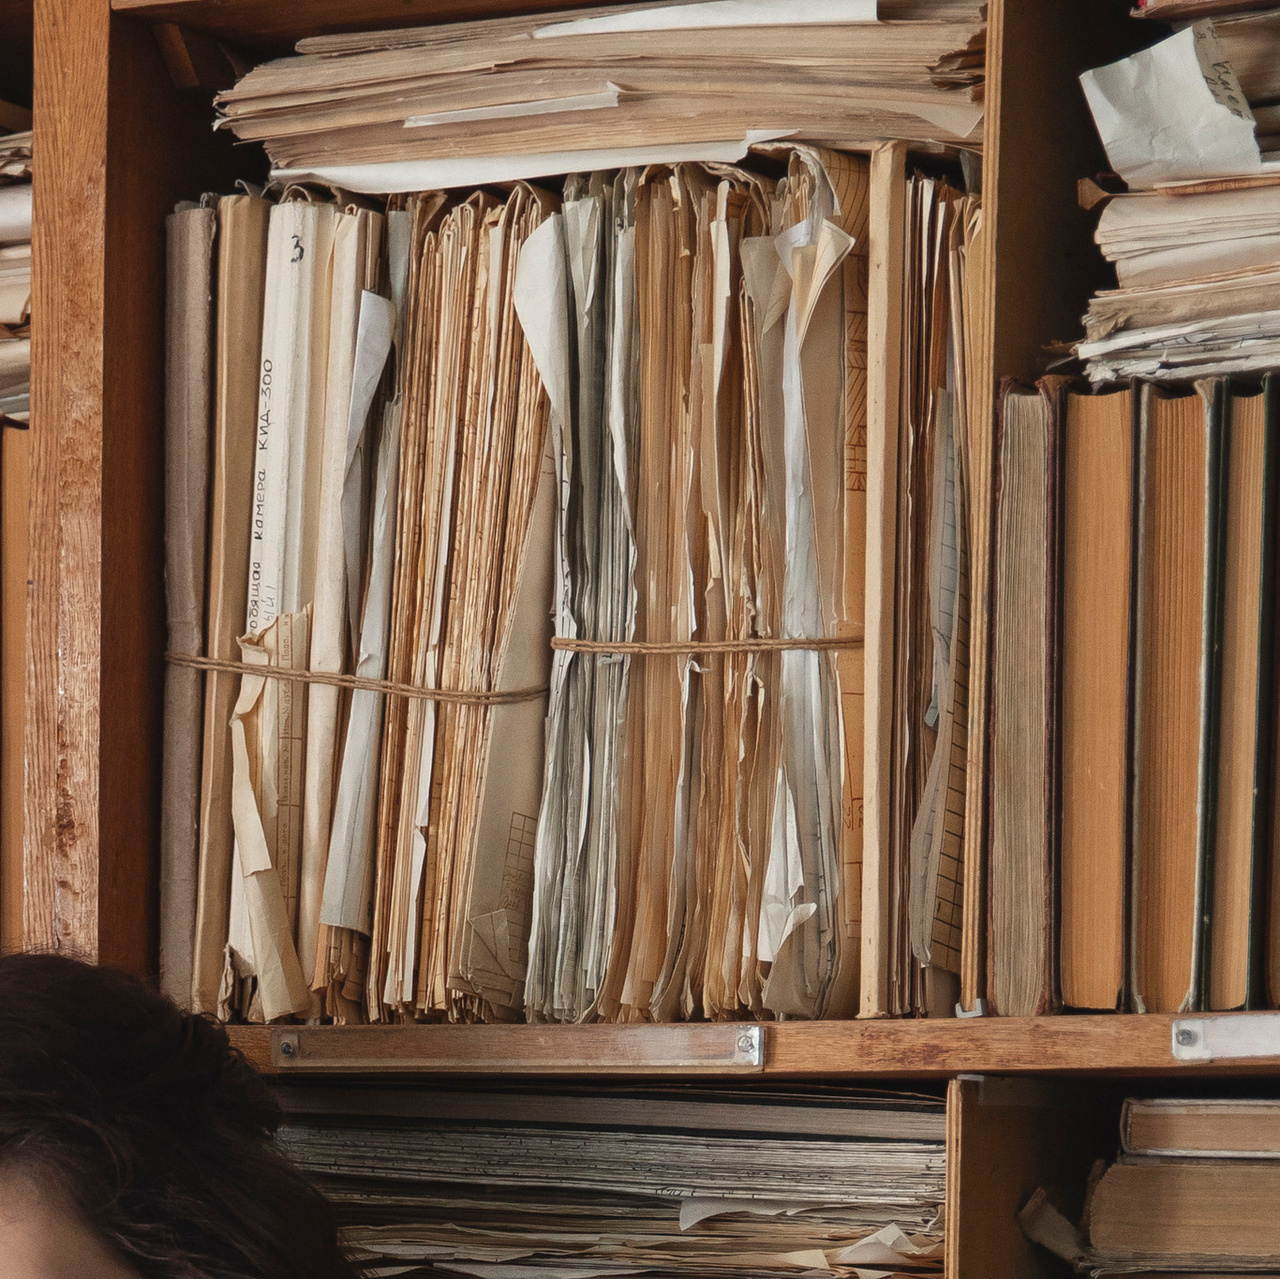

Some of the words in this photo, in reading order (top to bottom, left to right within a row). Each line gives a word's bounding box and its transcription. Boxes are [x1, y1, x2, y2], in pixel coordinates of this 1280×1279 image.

[290, 235, 305, 263] 3
[258, 359, 274, 450] КИД-300
[253, 468, 266, 540] камера
[249, 561, 261, 630] обящая
